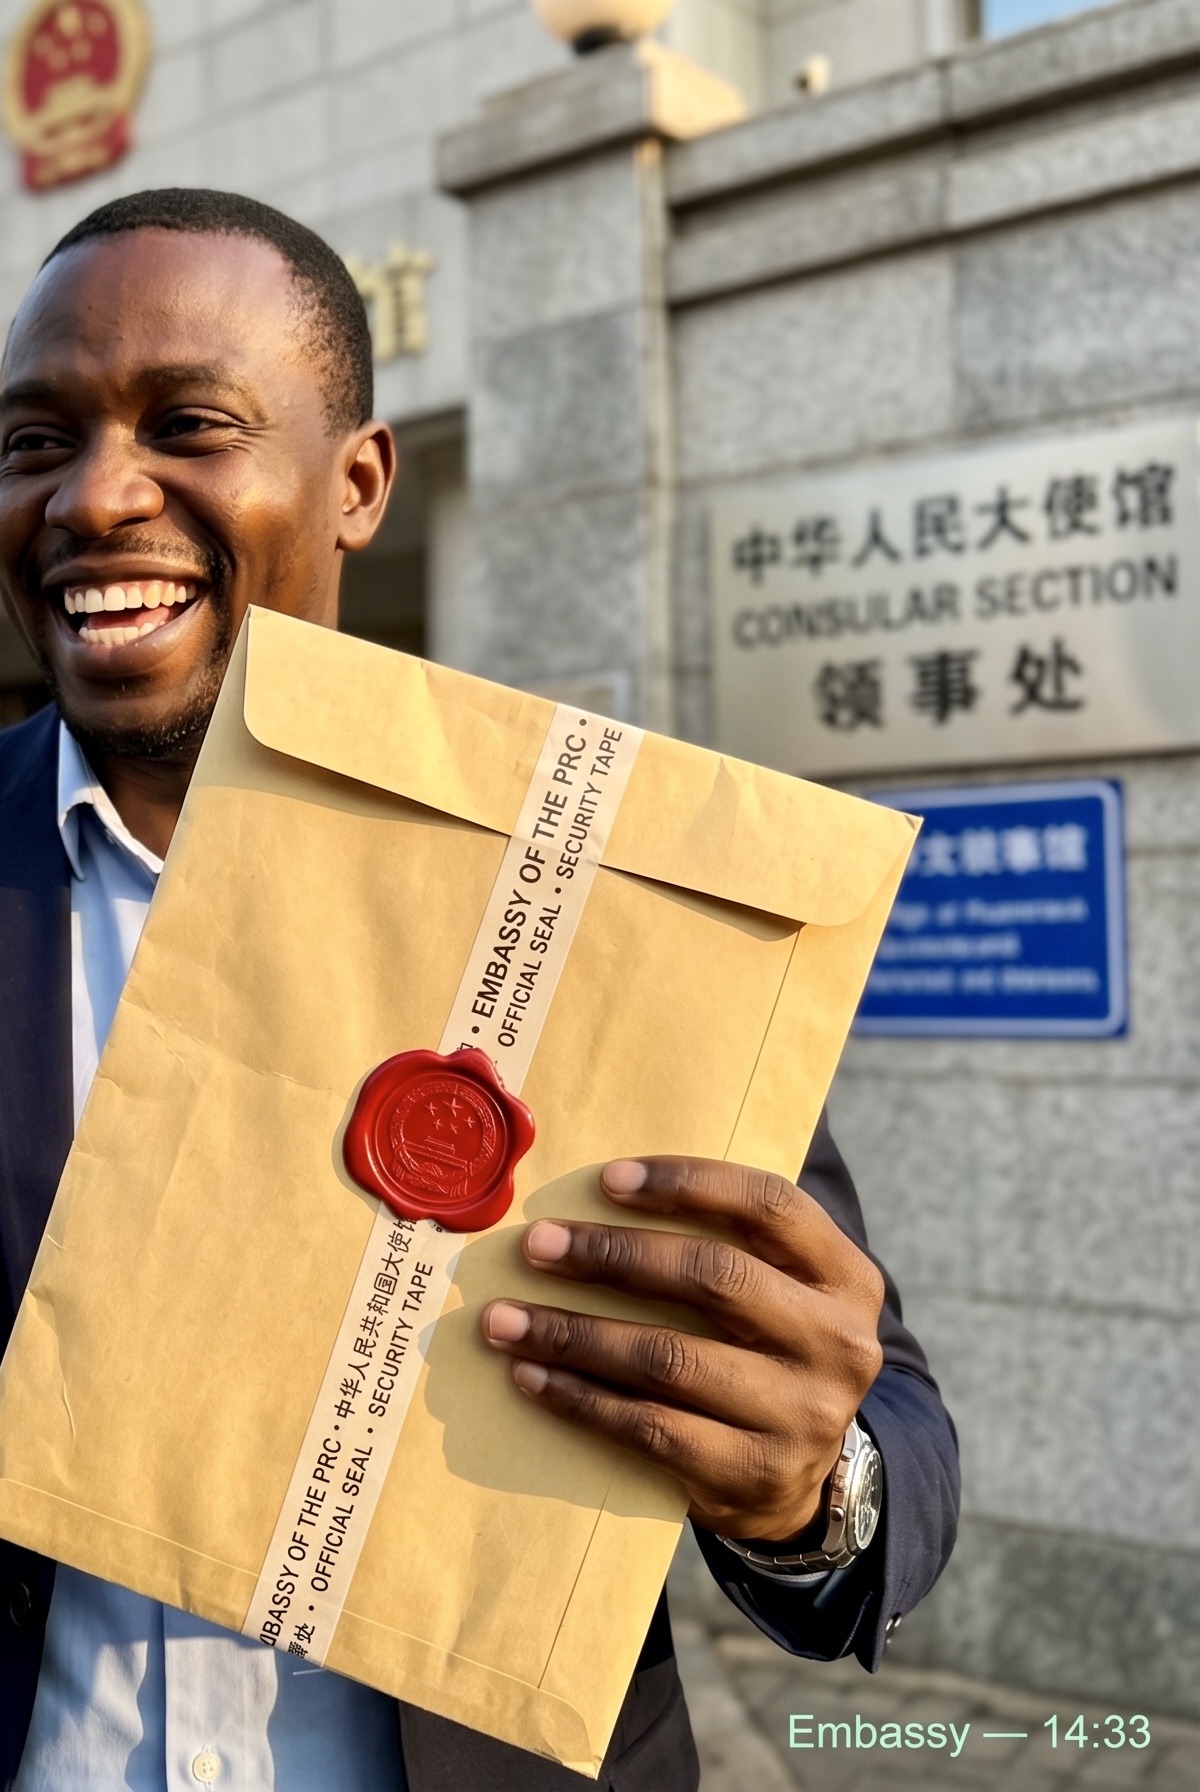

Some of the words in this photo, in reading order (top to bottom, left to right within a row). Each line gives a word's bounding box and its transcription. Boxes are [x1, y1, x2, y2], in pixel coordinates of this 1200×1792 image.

[732, 462, 1176, 587] 中华人民大使馆
[732, 581, 960, 650] CONSULAR
[973, 555, 1179, 620] SECTION
[813, 636, 1085, 732] 领事处
[552, 734, 587, 786] PRC
[532, 791, 568, 839] THE
[498, 961, 542, 1048] OFFICIAL
[530, 905, 562, 955] SEAL
[556, 782, 603, 880] SECURITY
[590, 728, 623, 777] TAPE
[519, 846, 546, 884] OF
[471, 889, 531, 1019] EMBASSY
[311, 1505, 354, 1593] OFFICIAL
[342, 1447, 374, 1497] SEAL
[368, 1317, 414, 1418] SECURITY
[402, 1262, 434, 1312] TAPE
[312, 1438, 342, 1484] PRC
[297, 1486, 327, 1527] THE
[288, 1531, 310, 1562] OF
